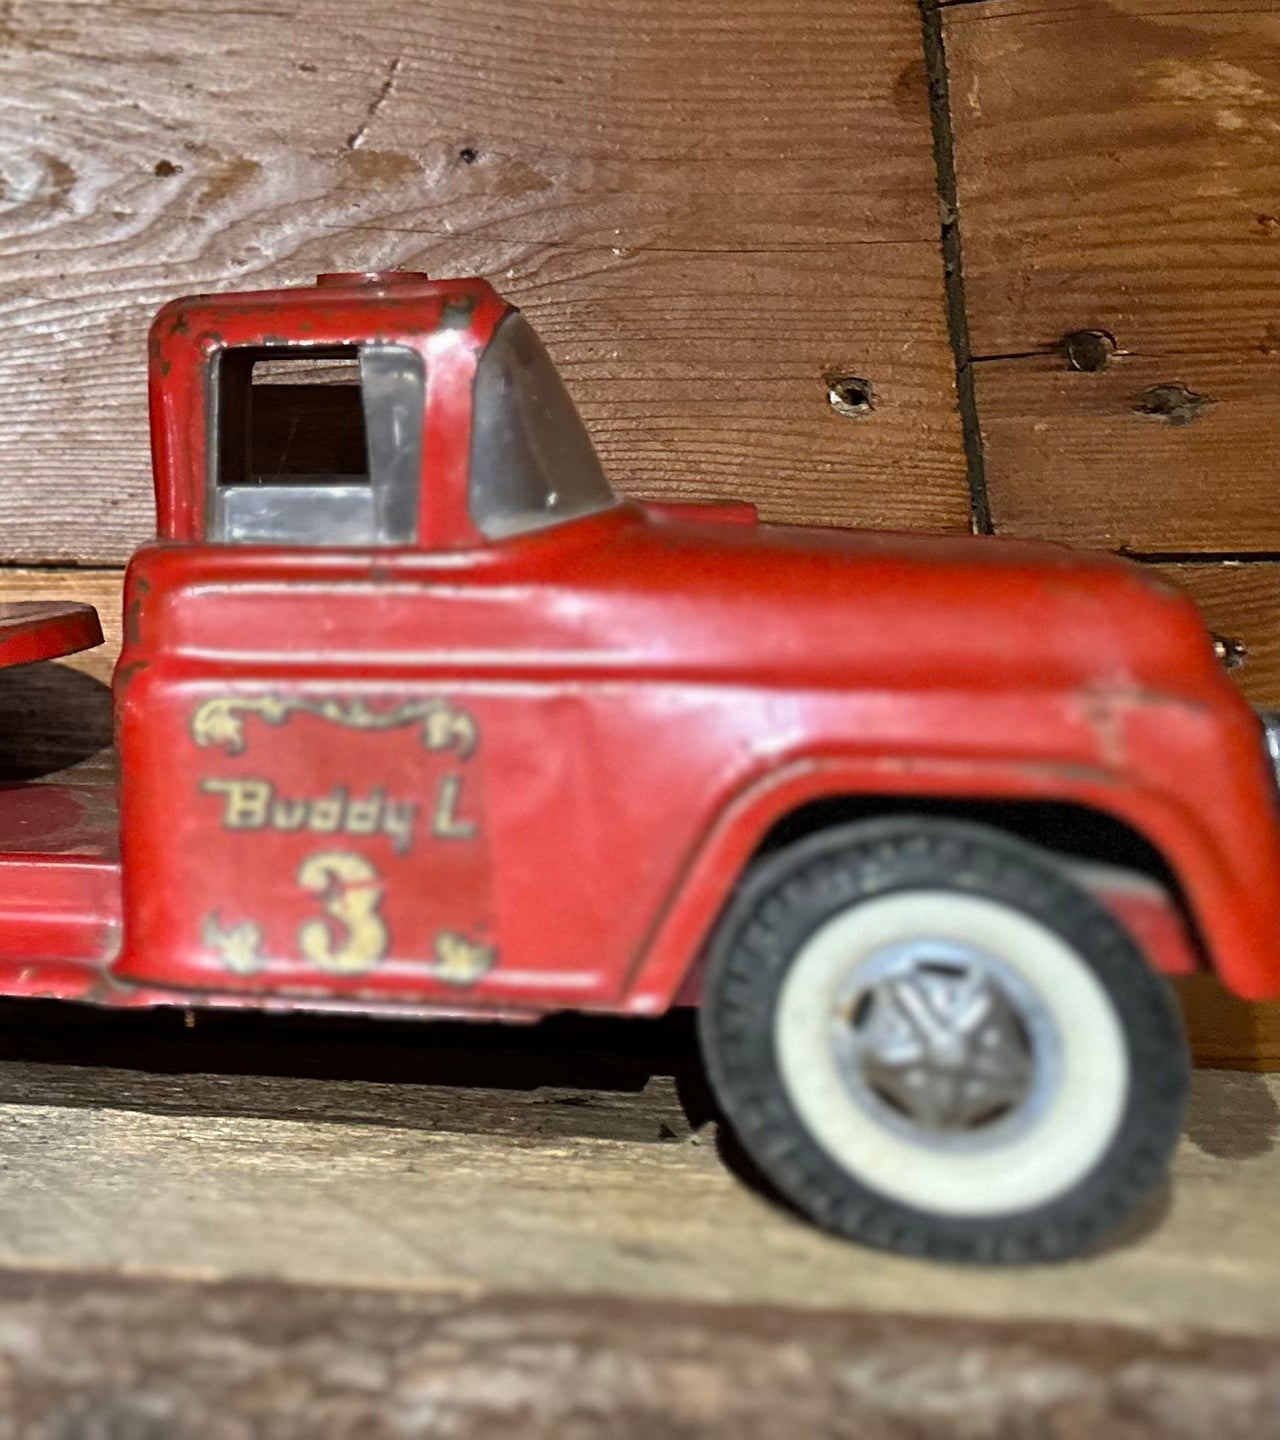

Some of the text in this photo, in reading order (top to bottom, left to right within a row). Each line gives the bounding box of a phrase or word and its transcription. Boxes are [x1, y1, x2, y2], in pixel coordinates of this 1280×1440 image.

[200, 774, 478, 856] Buddy L
[297, 851, 388, 976] 3
